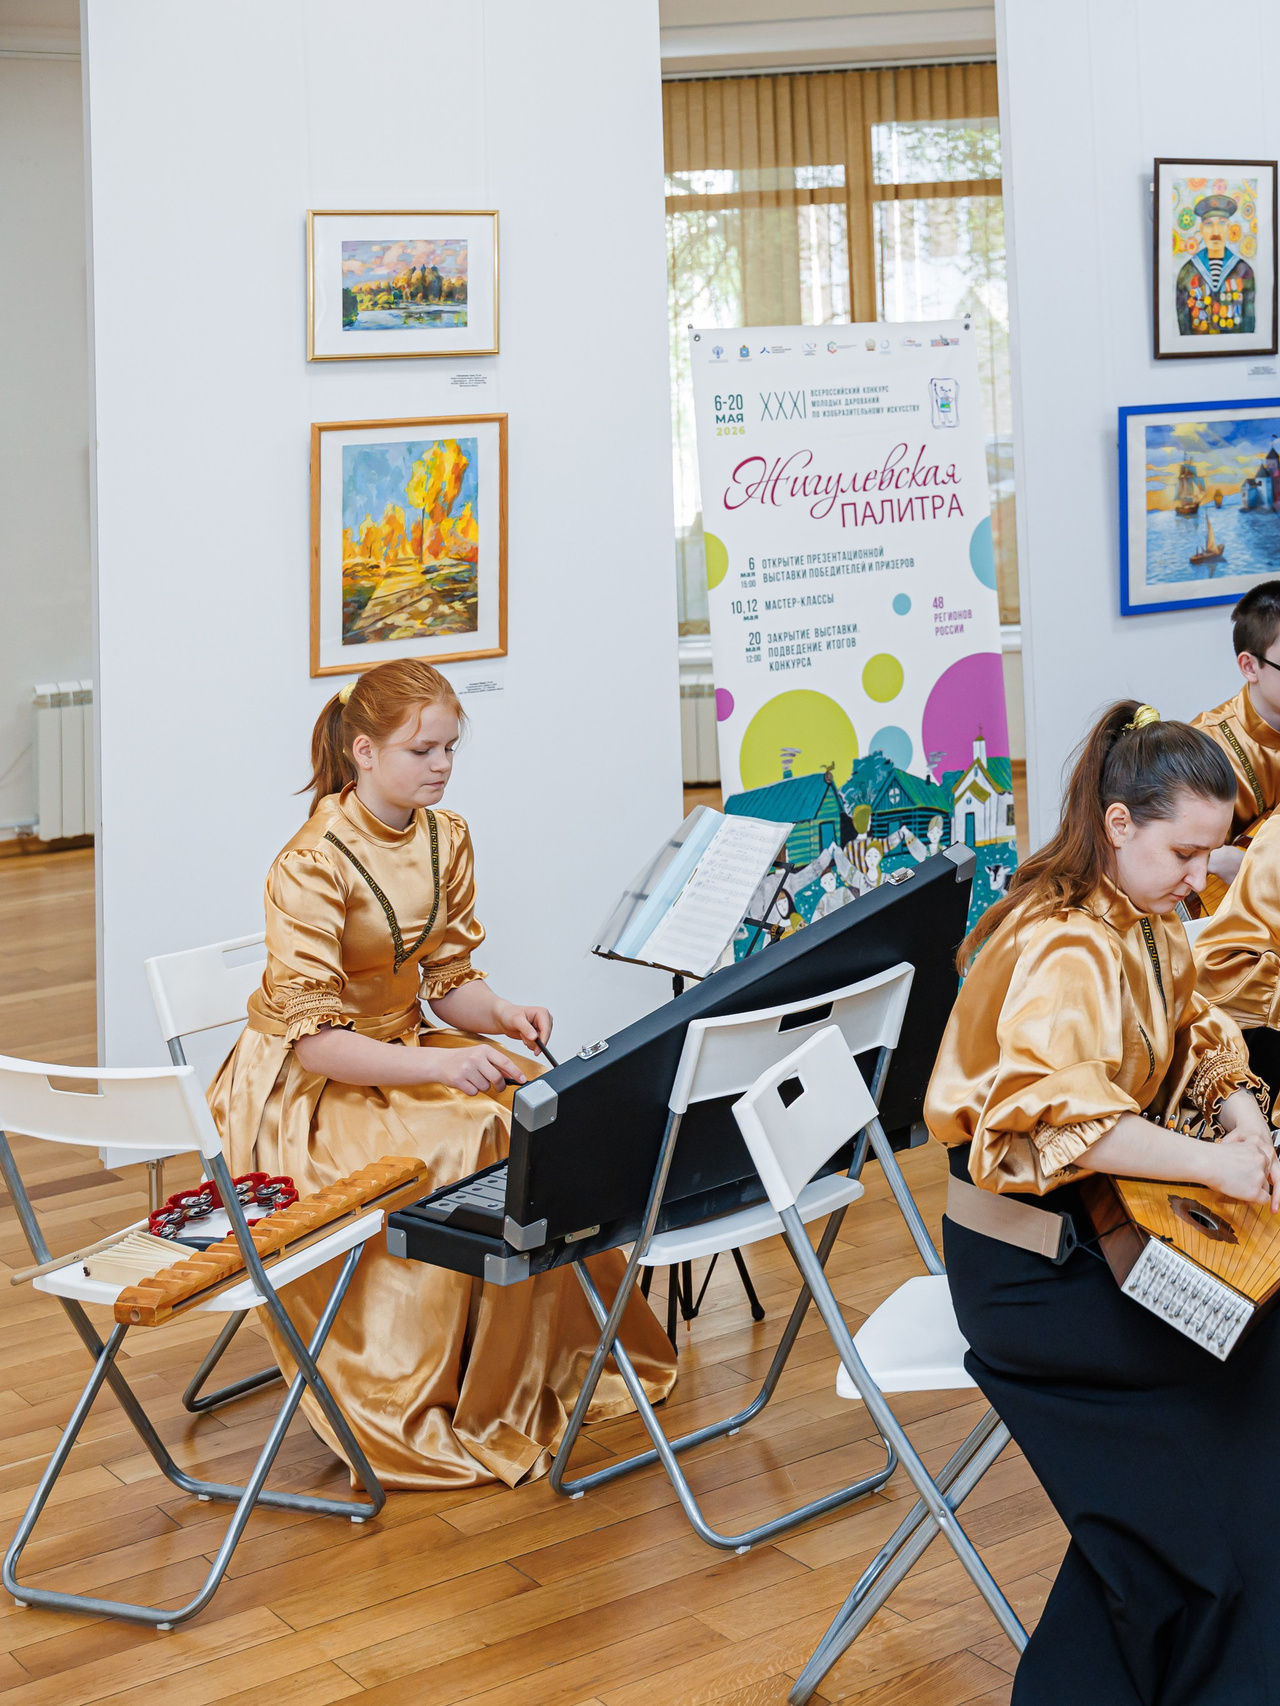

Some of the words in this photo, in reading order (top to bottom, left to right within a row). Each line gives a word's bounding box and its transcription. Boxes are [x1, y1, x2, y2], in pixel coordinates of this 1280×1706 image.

[810, 386, 860, 397] ВСЕРОССИЙСКИЙ
[863, 385, 889, 395] КОНКУРС
[714, 394, 744, 411] 6-20
[759, 390, 807, 421] XXXI
[811, 398, 842, 407] МОЛОДЫХ
[845, 396, 880, 406] ДАРОВАНИЙ
[715, 413, 744, 424] МАЯ
[812, 410, 820, 419] ПО
[823, 407, 884, 418] ИЗОБРАЗИТЕЛЬНОМУ
[887, 404, 920, 414] ИСКУССТВУ
[716, 426, 745, 436] 2026
[723, 442, 963, 520] Жигулевская
[841, 493, 964, 528] ПАЛИТРА
[748, 557, 755, 570] 6
[762, 555, 804, 569] ОТКРЫТИЕ
[806, 545, 884, 564] ПРЕЗЕНТАЦИОННОЙ
[763, 568, 807, 583] ВЫСТАВКИ
[809, 561, 866, 578] ПОБЕДИТЕЛЕЙ
[868, 561, 873, 571] И
[875, 557, 915, 571] ПРИЗЕРОВ
[740, 579, 756, 589] 15:00
[731, 599, 758, 614] 10,12
[765, 593, 834, 610] МАСТЕР-КЛАССЫ
[932, 596, 944, 609] 48
[934, 609, 972, 623] РЕГИОНОВ
[767, 629, 810, 644] ЗАКРЫТИЕ
[814, 623, 860, 638] ВЫСТАВКИ.
[935, 624, 964, 636] РОССИИ
[748, 631, 761, 646] 20
[768, 641, 822, 658] ПОДВЕДЕНИЕ
[826, 637, 857, 651] ИТОГОВ
[746, 654, 761, 663] 12:00
[769, 657, 812, 672] КОНКУРСА
